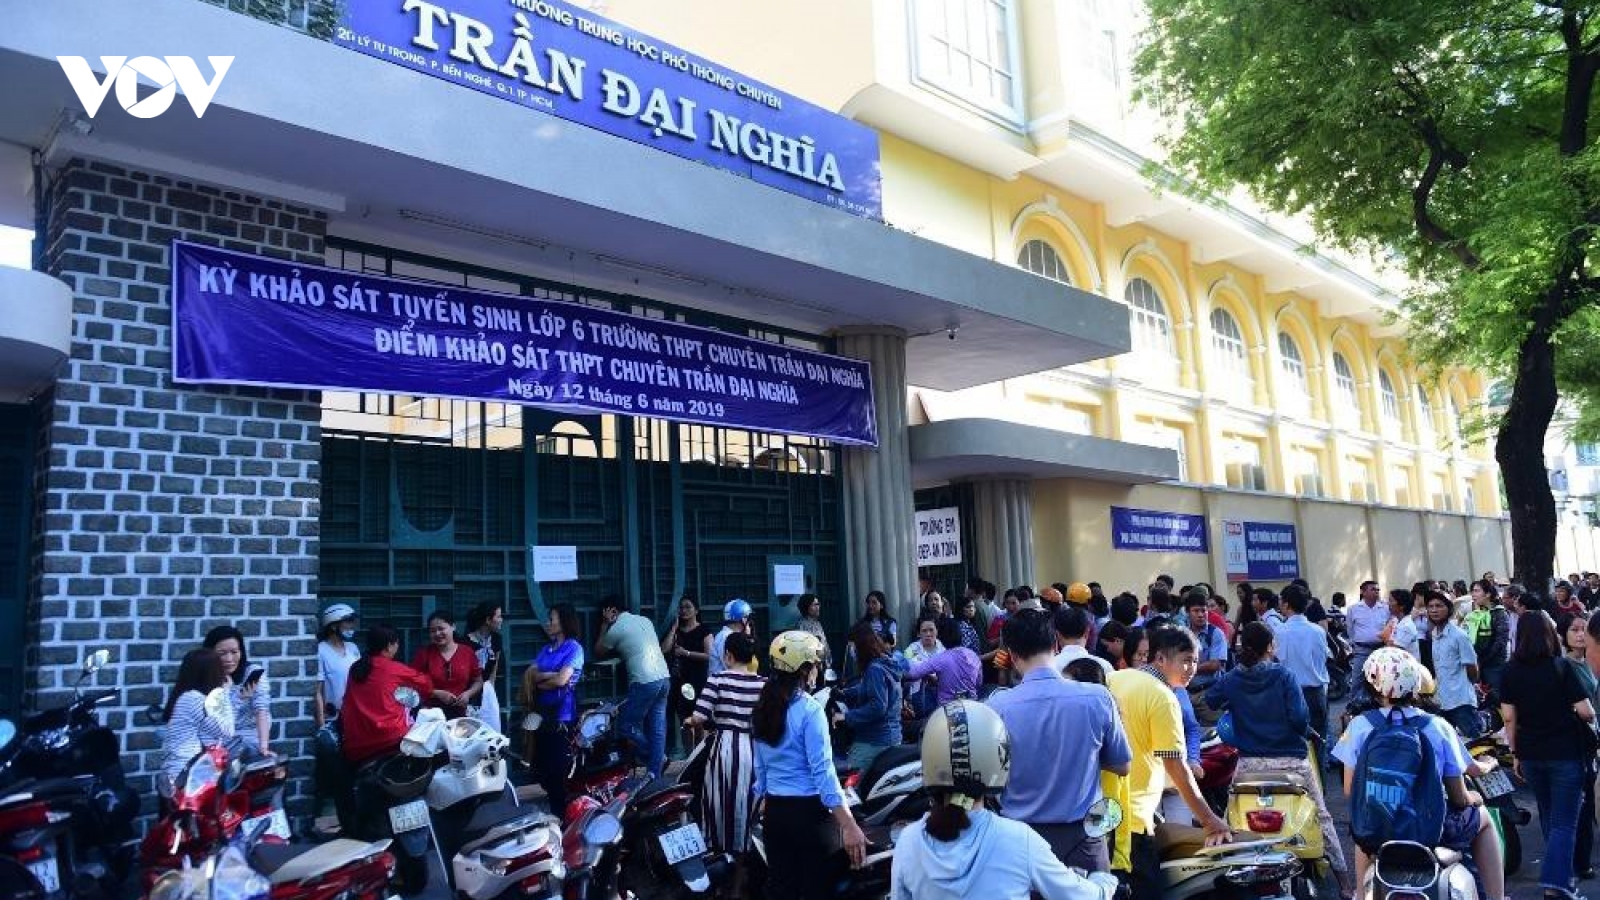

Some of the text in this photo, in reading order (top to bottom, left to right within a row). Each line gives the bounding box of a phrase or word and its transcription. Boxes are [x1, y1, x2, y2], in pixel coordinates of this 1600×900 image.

[402, 0, 846, 192] TRẦN ĐẠI NGHĨA
[576, 17, 624, 46] TRUNG
[627, 37, 659, 61] HỌC
[662, 50, 689, 72] PHỔ
[691, 63, 735, 91] THÔNG
[737, 82, 782, 110] CHUYÊN
[199, 260, 239, 296] KỲ
[249, 268, 326, 307] KHẢO
[332, 281, 381, 313] SÁT
[473, 304, 523, 333] SINH
[527, 307, 567, 339] LỚP
[572, 319, 585, 341] 6
[588, 321, 660, 354] TRƯỜNG
[662, 335, 704, 362] THPT
[708, 343, 768, 373] CHUYÊN
[768, 350, 806, 379] TRẦN
[808, 361, 829, 387] ĐẠI
[831, 366, 866, 390] NGHĨA
[374, 319, 800, 405] ĐIỂM KHẢO SÁT THPT CHUYÊN TRẦN ĐẠI NGHĨA
[508, 377, 725, 418] Ngày 12 tháng 6 năm 2019
